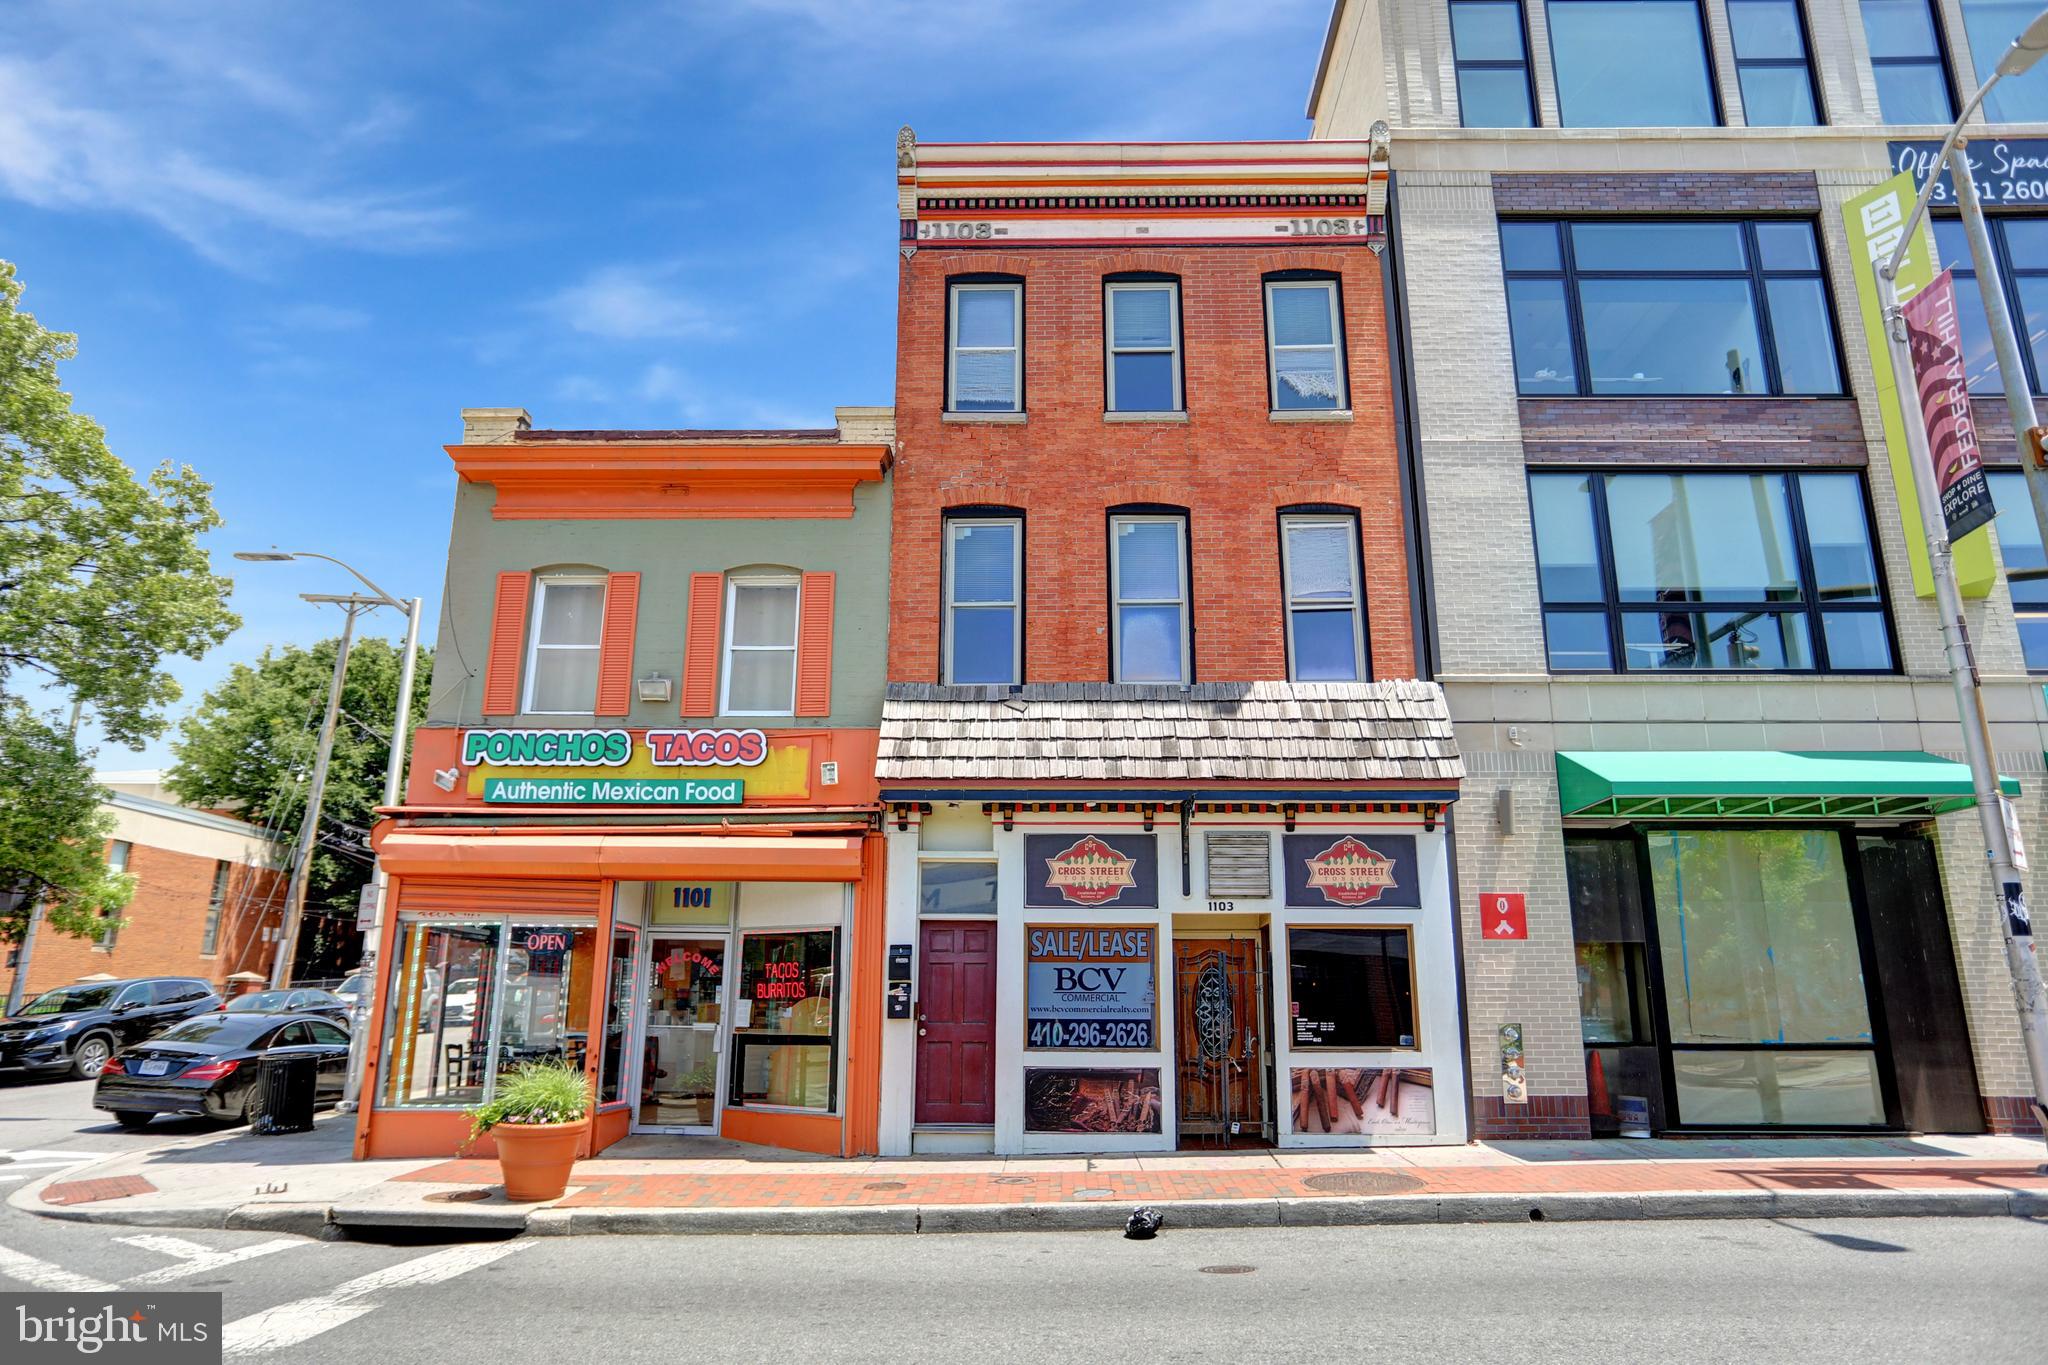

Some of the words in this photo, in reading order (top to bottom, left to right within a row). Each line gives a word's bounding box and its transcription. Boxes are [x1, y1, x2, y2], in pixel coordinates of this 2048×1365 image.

[2000, 181, 2048, 200] 260
[931, 223, 992, 239] 1103
[1290, 218, 1350, 236] 1103
[1935, 286, 1957, 347] HILL
[1944, 345, 1978, 470] FEDERAL
[1942, 487, 1956, 504] SHOP
[1962, 471, 1982, 488] DINE
[1943, 481, 1986, 516] EXPLORE
[464, 732, 630, 763] PONCHOS
[649, 732, 765, 763] TACOS
[492, 781, 586, 801] Authentic
[593, 781, 679, 801] Mexican
[685, 781, 735, 801] Food
[1058, 866, 1086, 876] CROSS
[1090, 866, 1126, 876] STREET
[1318, 867, 1346, 877] CROSS
[1350, 867, 1385, 877] STREET
[673, 887, 712, 909] 1101
[1208, 901, 1234, 912] 1103
[527, 934, 567, 950] OPEN
[1031, 930, 1149, 960] SALE/LEASE
[656, 951, 721, 976] WELCOME
[764, 962, 800, 979] TACOS
[1053, 967, 1127, 991] BCV
[756, 981, 806, 999] BURRITOS
[1061, 993, 1121, 1002] COMMERCIAL
[1030, 1004, 1150, 1015] www.bcvcommercialrealty.com
[1030, 1022, 1149, 1047] 410-296-2626
